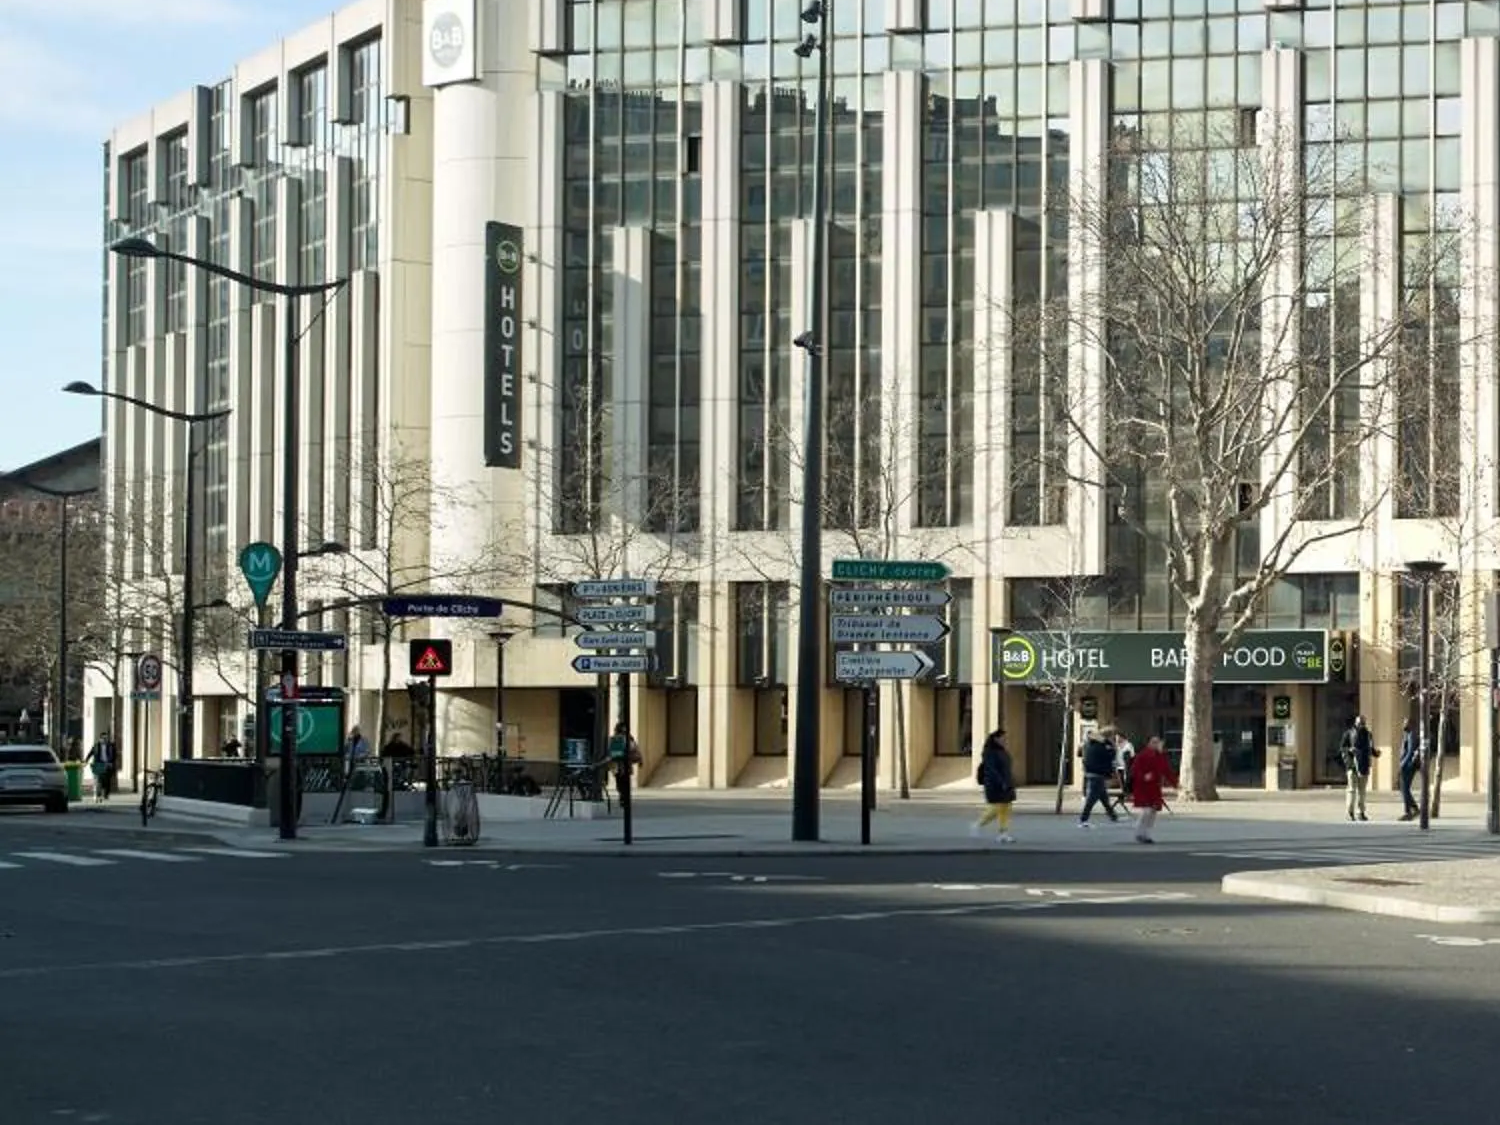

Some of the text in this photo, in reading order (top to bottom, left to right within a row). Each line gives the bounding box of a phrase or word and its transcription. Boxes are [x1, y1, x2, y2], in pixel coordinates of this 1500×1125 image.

[500, 285, 515, 456] HOTELS
[249, 551, 271, 572] M
[1003, 649, 1029, 663] B&B
[1042, 647, 1110, 669] HOTEL
[1307, 656, 1323, 668] BE
